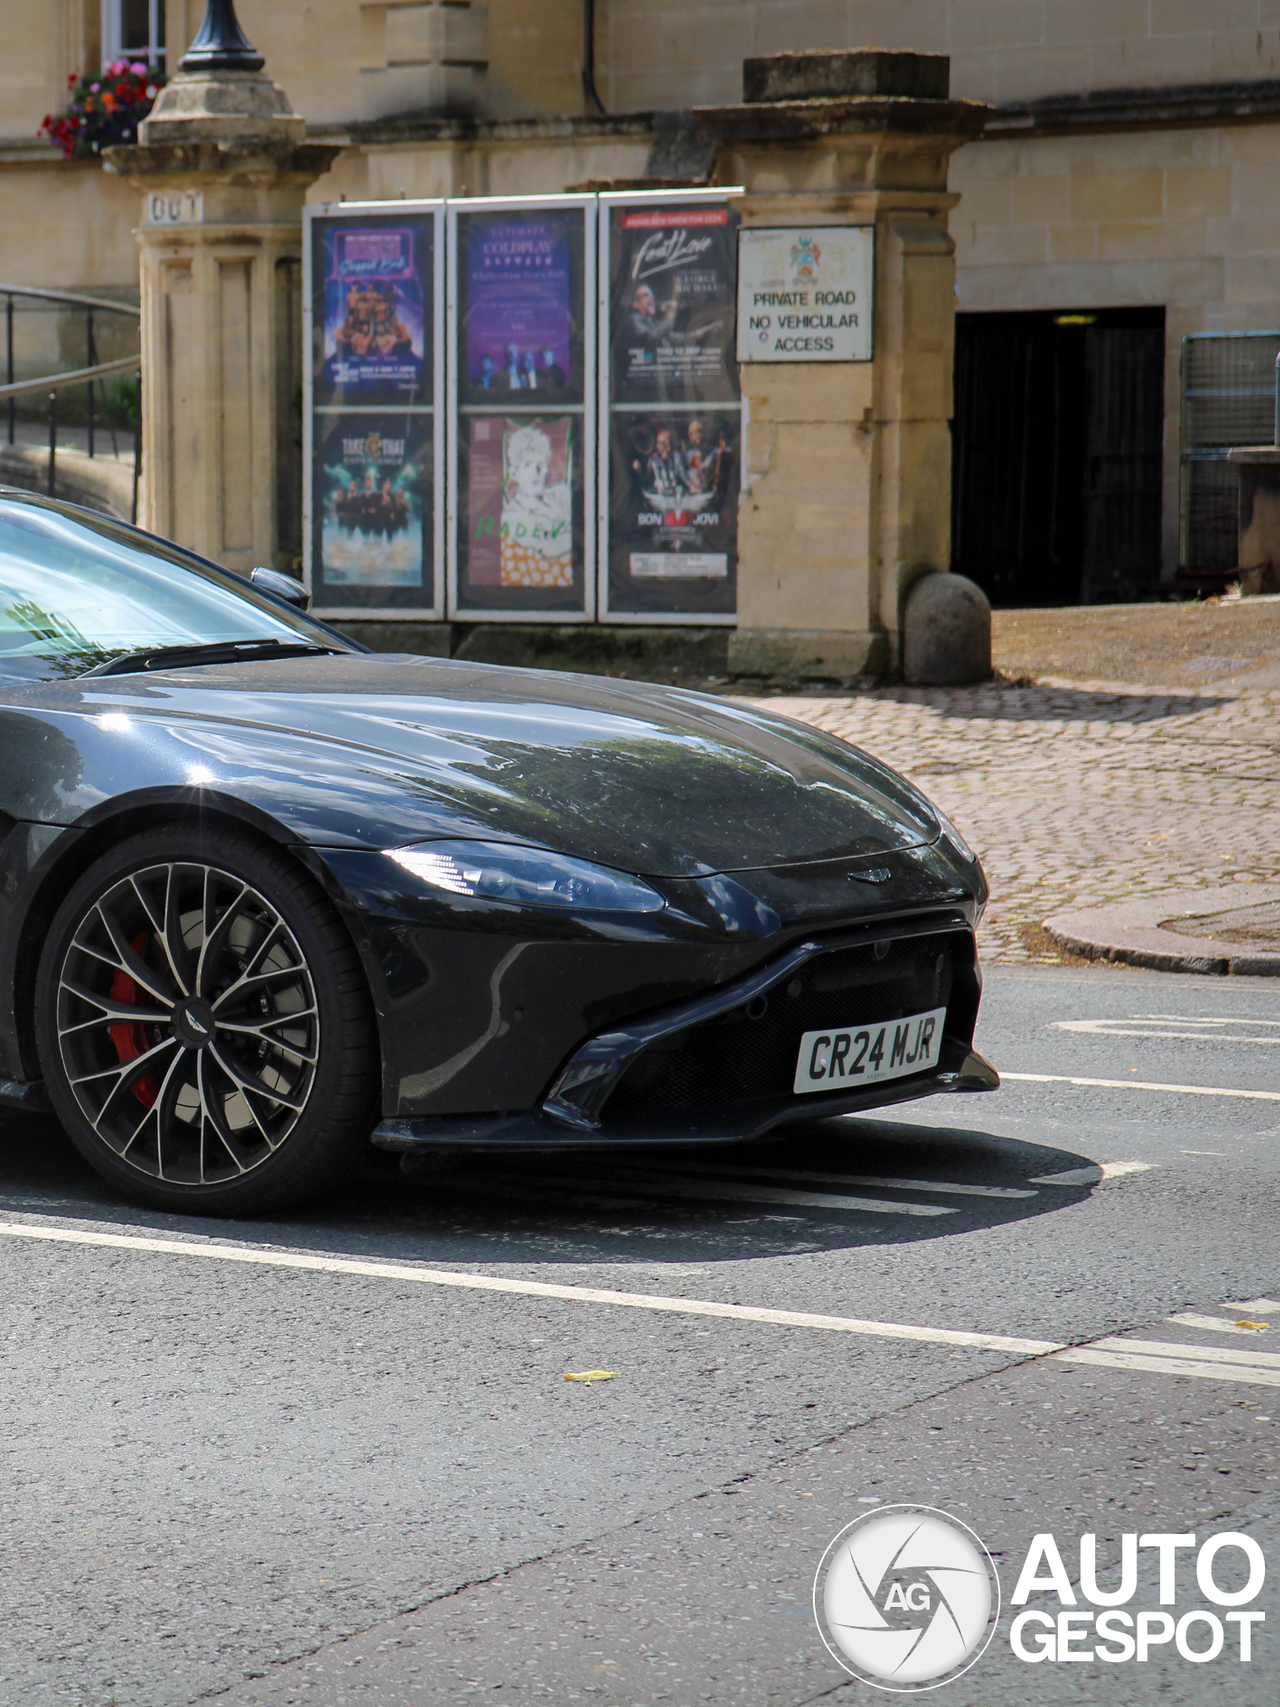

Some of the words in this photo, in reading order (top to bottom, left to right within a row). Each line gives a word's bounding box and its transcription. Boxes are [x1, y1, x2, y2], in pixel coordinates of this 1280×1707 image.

[482, 240, 553, 254] COLDPLAY
[753, 292, 809, 307] PRIVATE
[815, 290, 856, 306] ROAD
[749, 315, 771, 329] NO
[777, 313, 859, 330] VEHICULAR
[774, 337, 834, 352] ACCESS
[637, 512, 662, 526] BON
[692, 512, 719, 526] JOVI
[809, 1028, 886, 1080] CR24
[889, 1016, 936, 1069] MJR
